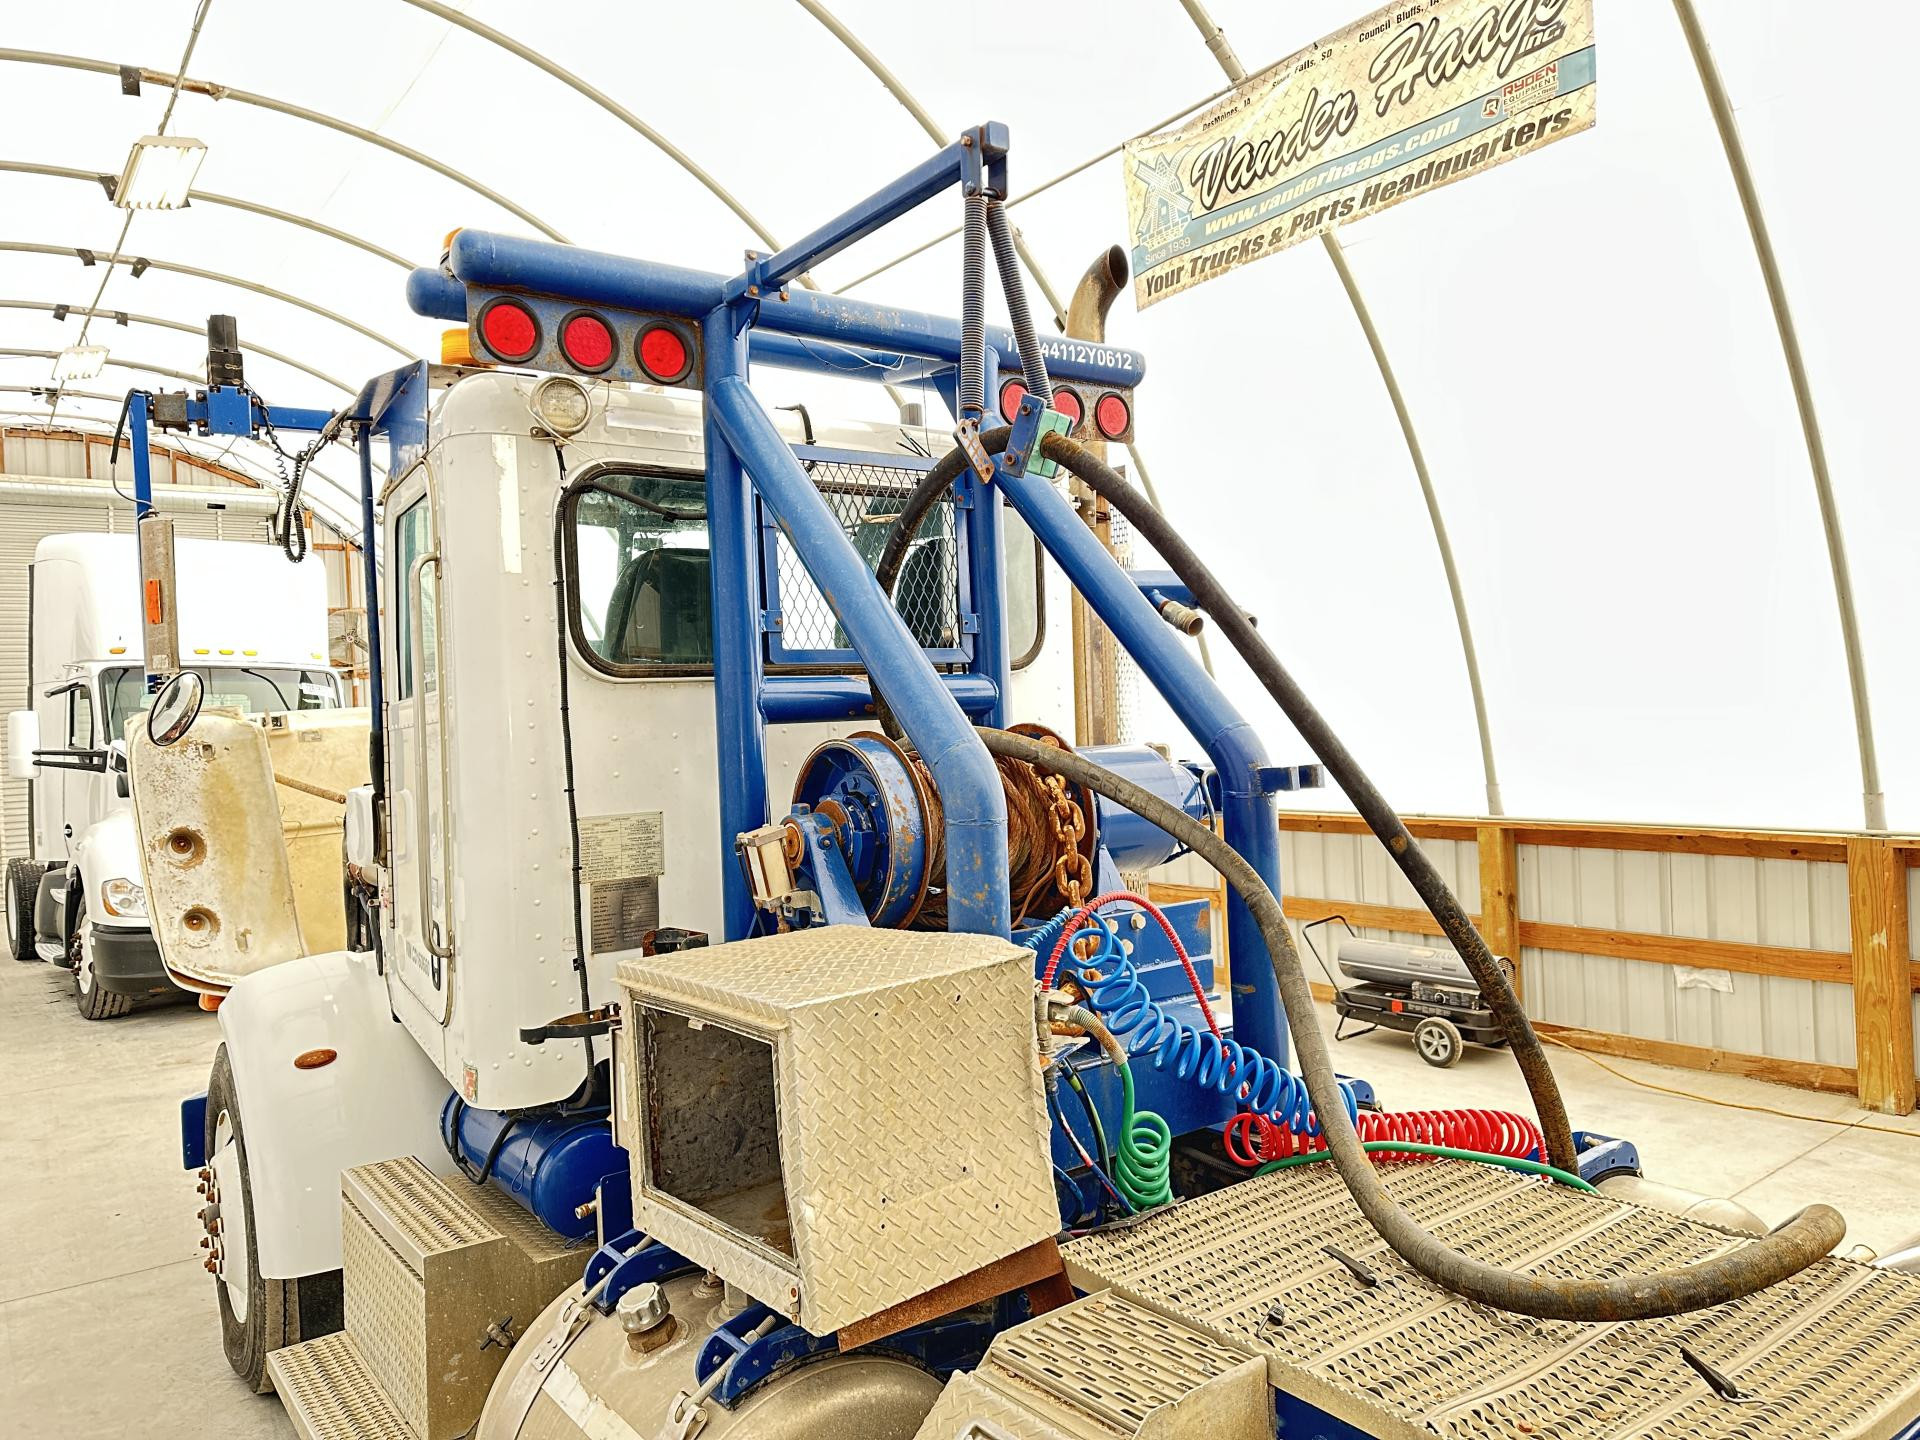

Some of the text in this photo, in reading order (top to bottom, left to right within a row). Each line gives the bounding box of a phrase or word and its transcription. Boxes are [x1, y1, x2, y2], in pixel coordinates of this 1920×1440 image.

[1359, 20, 1391, 43] Council
[1503, 75, 1557, 105] EQUIPMENT
[1190, 87, 1358, 210] Vander
[1205, 117, 1460, 236] www.vanderhaags.com
[1146, 108, 1573, 297] Your Trucks & Parts Headquarters
[1168, 236, 1191, 254] 1939
